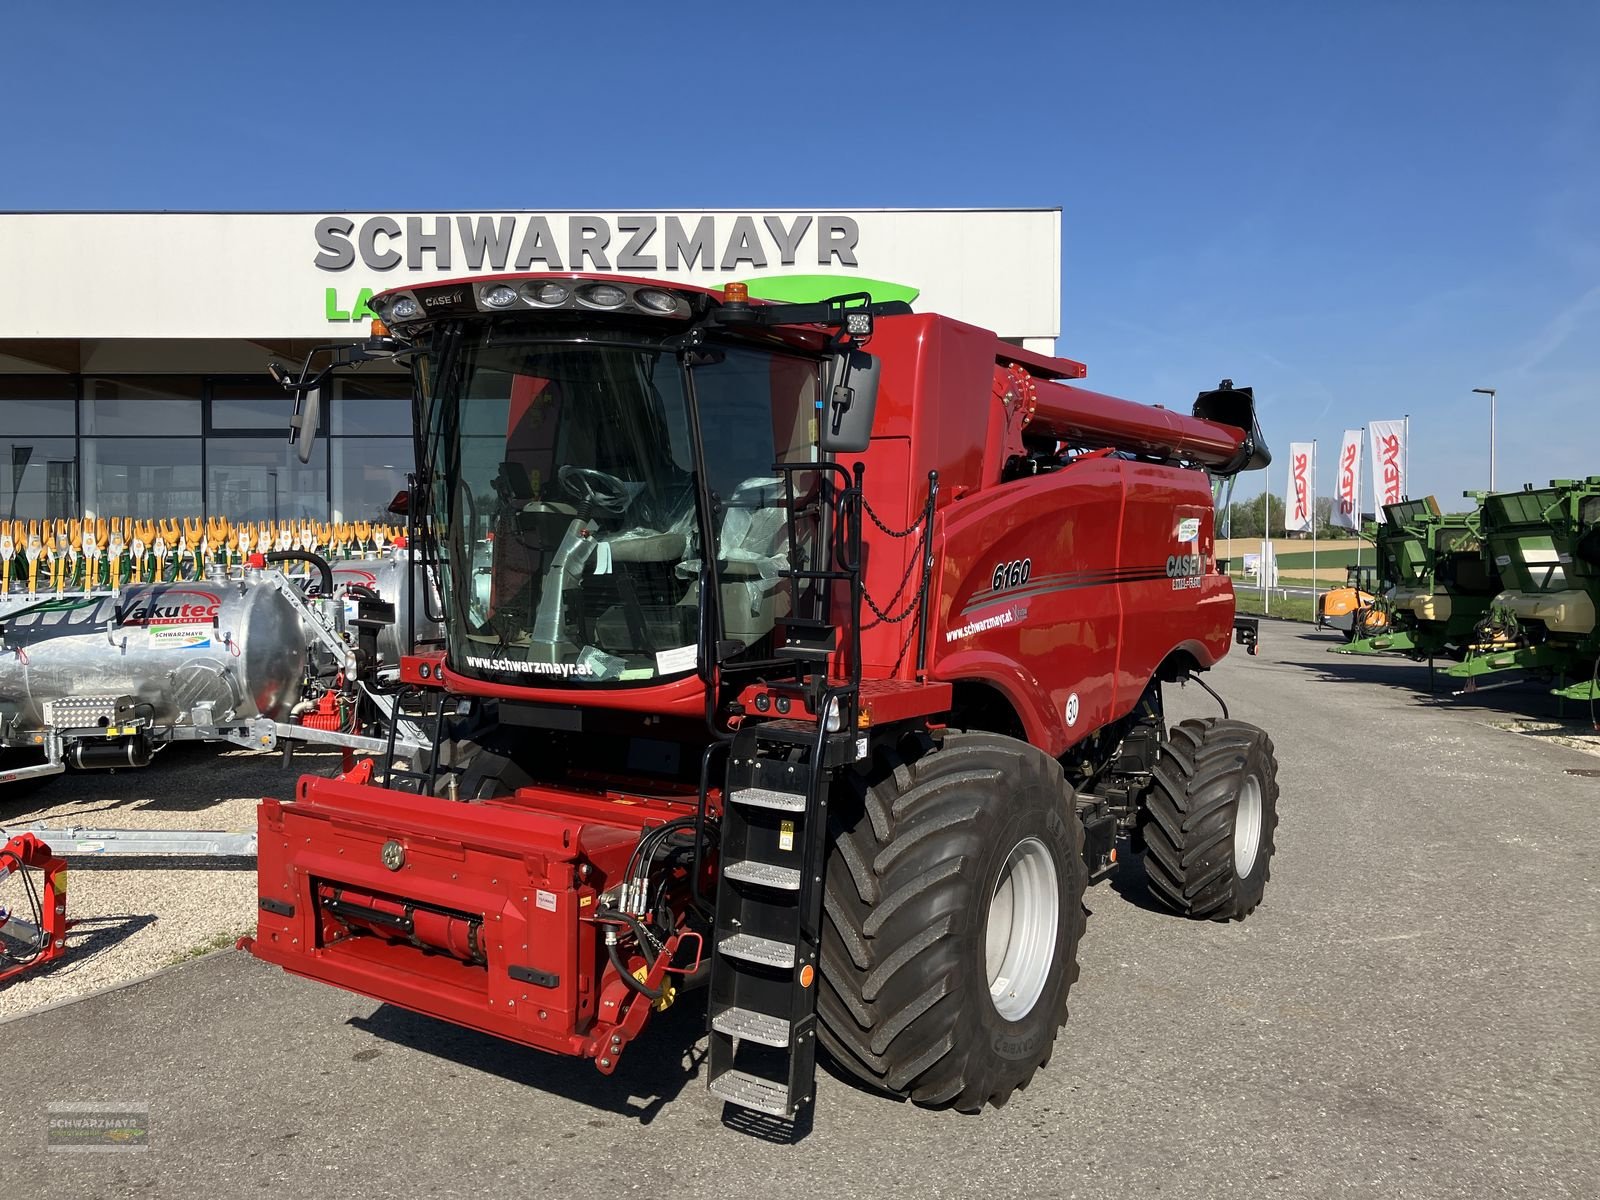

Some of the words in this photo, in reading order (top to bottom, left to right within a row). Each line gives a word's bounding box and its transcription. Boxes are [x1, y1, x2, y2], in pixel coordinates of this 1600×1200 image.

[313, 215, 860, 271] SCHWARZMAYR
[325, 287, 392, 323] LA
[425, 297, 451, 308] CASE
[991, 558, 1031, 592] 6160
[1166, 555, 1196, 577] CASE
[114, 600, 220, 625] Vakutec
[946, 609, 1013, 643] www.schwarzmayr.at
[466, 656, 592, 678] www.schwarzmayr.at
[1068, 698, 1077, 721] 30
